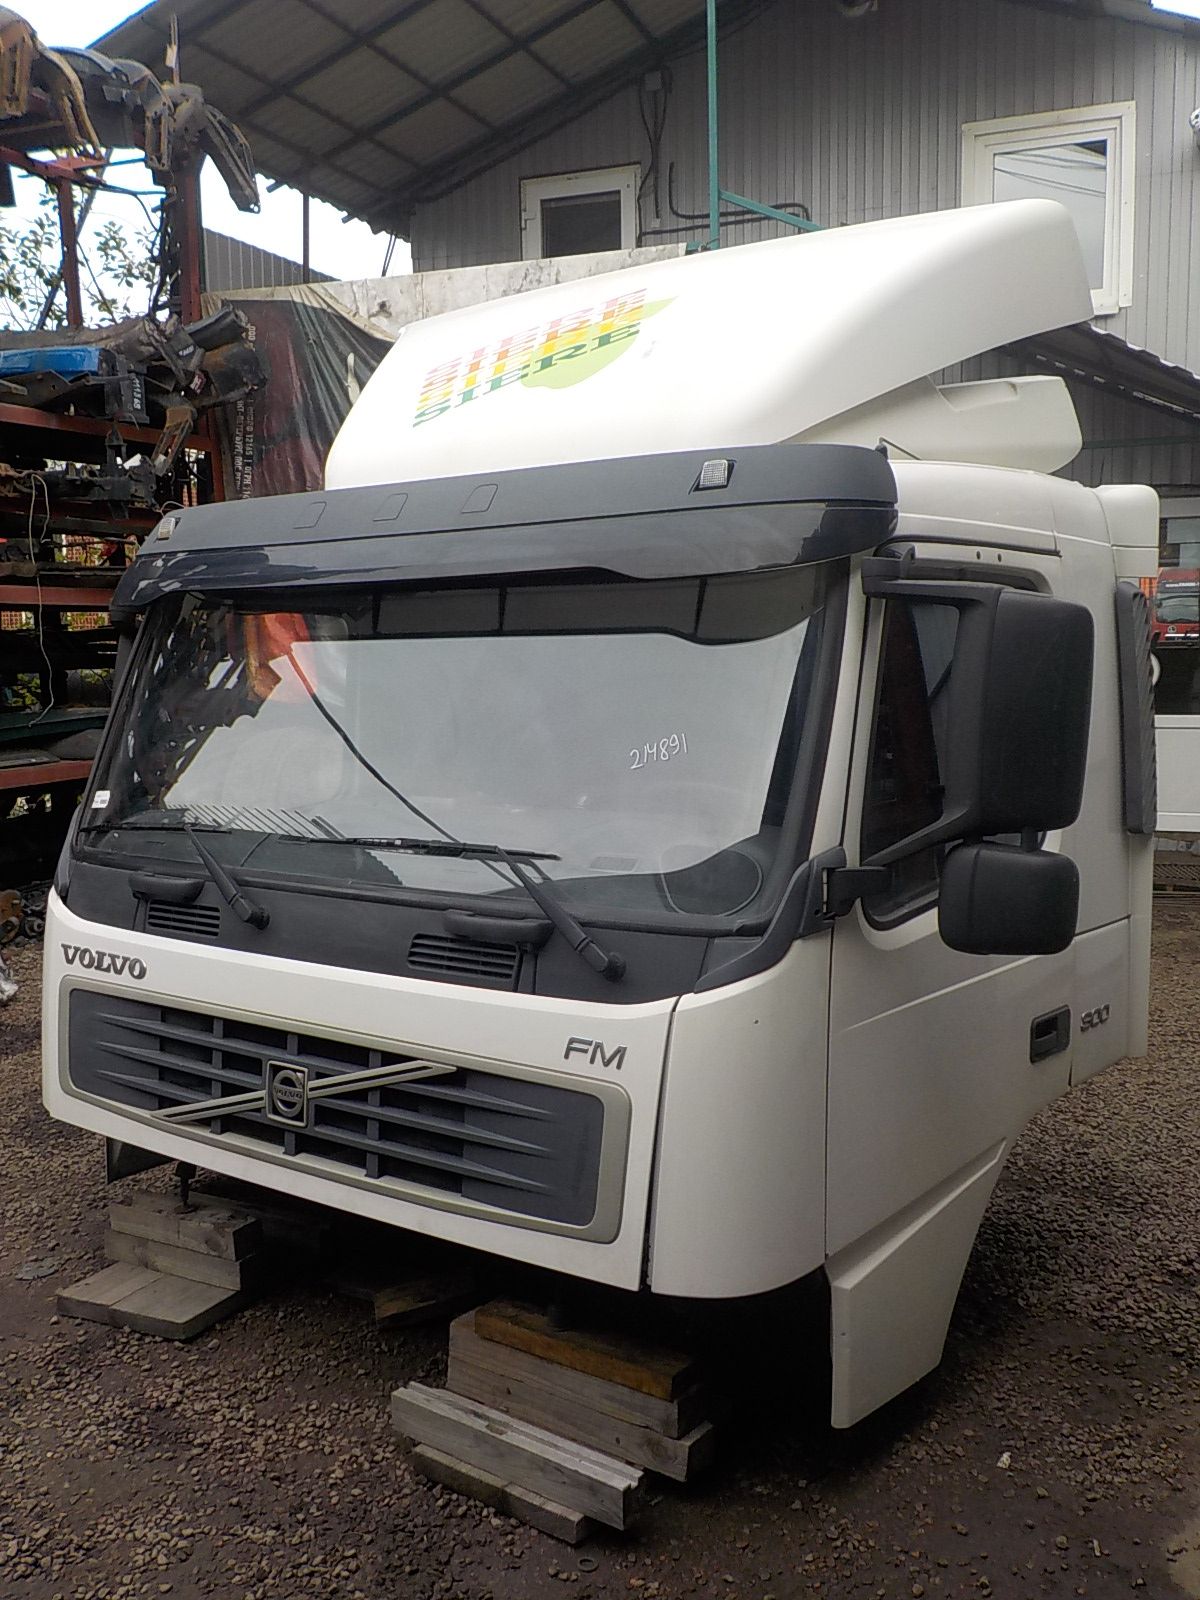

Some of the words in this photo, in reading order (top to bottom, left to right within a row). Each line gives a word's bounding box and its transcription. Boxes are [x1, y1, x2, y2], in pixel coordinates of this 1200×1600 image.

[413, 322, 641, 428] SIERE
[629, 733, 688, 769] 214891
[60, 943, 147, 980] VOLVO
[563, 1036, 628, 1070] FM
